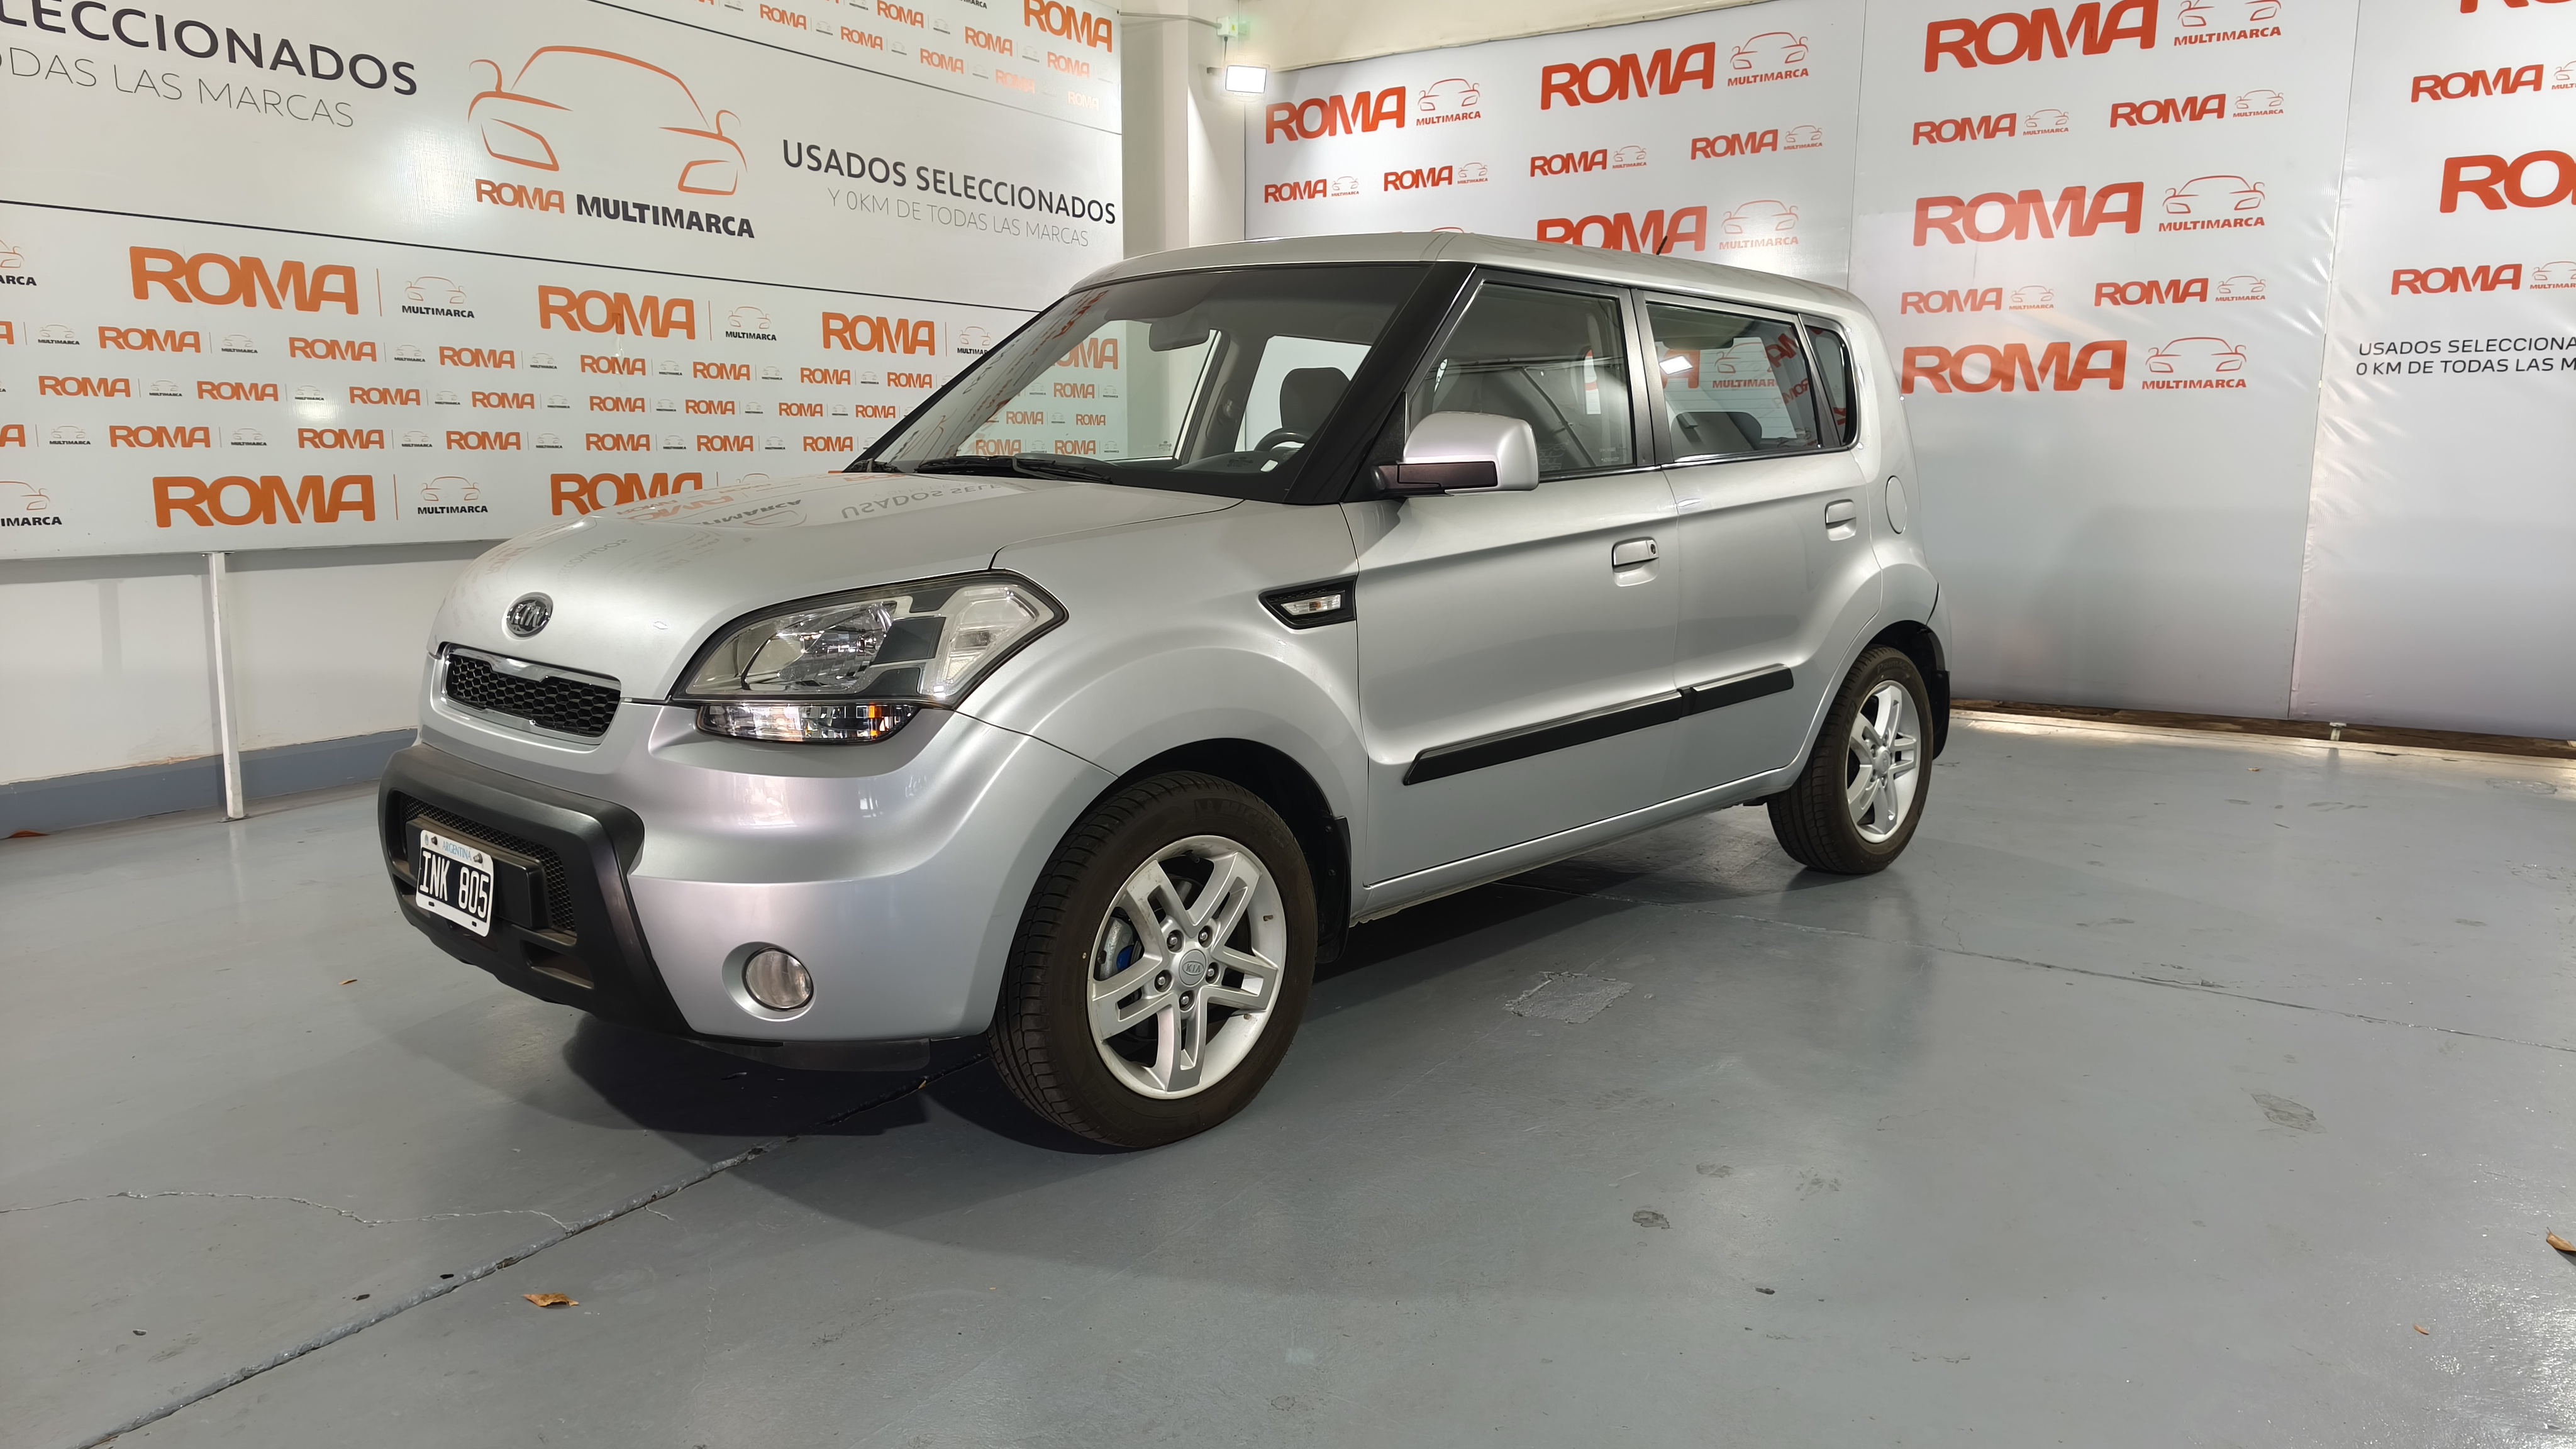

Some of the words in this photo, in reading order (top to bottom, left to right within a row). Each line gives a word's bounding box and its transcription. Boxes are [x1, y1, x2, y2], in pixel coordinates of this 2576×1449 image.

[760, 4, 807, 30] ROMA
[877, 0, 923, 28] ROMA
[841, 26, 883, 50] ROMA
[1024, 0, 1113, 53] ROMA
[1924, 0, 2158, 72] ROMA
[2174, 26, 2281, 47] MULTIMARCA
[965, 26, 1013, 57] ROMA
[920, 48, 964, 74] ROMA
[1048, 52, 1089, 78] ROMA
[0, 47, 96, 86] DAS
[114, 65, 182, 100] LAS
[199, 79, 354, 128] MARCAS
[996, 70, 1035, 94] ROMA
[1541, 42, 1716, 110] ROMA
[1728, 68, 1809, 86] MULTIMARCA
[2411, 64, 2544, 103] ROMA
[1068, 91, 1099, 111] ROMA
[2110, 94, 2226, 128] ROMA
[2233, 109, 2284, 118] MULTIMARCA
[1266, 86, 1406, 144] ROMA
[1416, 111, 1481, 126] MULTIMARCA
[1913, 113, 2017, 145] ROMA
[2023, 127, 2069, 136] MULTIMARCA
[1691, 129, 1778, 160] ROMA
[1784, 142, 1823, 151] MULTIMARCA
[1530, 149, 1607, 177] ROMA
[783, 140, 906, 187] USADOS
[916, 166, 1116, 225] SELECCIONADOS
[1384, 165, 1453, 191] ROMA
[2440, 150, 2576, 213] RO
[1264, 179, 1327, 203] ROMA
[475, 179, 565, 214] ROMA
[577, 194, 755, 238] MULTIMARCA
[828, 188, 840, 206] Y
[897, 199, 921, 221] DE
[926, 204, 987, 231] TODAS
[993, 218, 1020, 236] LAS
[1026, 221, 1089, 247] MARCAS
[1913, 181, 2145, 247] ROMA
[2158, 217, 2265, 232] MULTIMARCA
[1537, 206, 1707, 255] ROMA
[1719, 235, 1799, 250] MULTIMARCA
[129, 246, 358, 315] ROMA
[402, 306, 474, 318] MULTIMARCA
[2391, 264, 2523, 295] ROMA
[1901, 287, 2003, 314] ROMA
[2094, 278, 2209, 307] ROMA
[538, 285, 696, 340] ROMA
[726, 331, 777, 341] MULTIMARCA
[98, 326, 201, 352] ROMA
[822, 311, 936, 356] ROMA
[289, 337, 377, 362] ROMA
[439, 347, 514, 370] ROMA
[1054, 338, 1118, 370] OMA
[2359, 340, 2441, 356] USADOS
[580, 355, 646, 376] ROMA
[693, 362, 750, 380] ROMA
[801, 367, 851, 386] ROMA
[1901, 340, 2128, 394] ROMA
[2141, 379, 2246, 390] MULTIMARCA
[2373, 362, 2401, 375] KM
[2408, 361, 2434, 374] DE
[2440, 359, 2509, 373] TODAS
[2516, 358, 2554, 371] LAS
[39, 375, 131, 397] ROMA
[197, 381, 279, 401] ROMA
[887, 372, 932, 389] ROMA
[1053, 382, 1094, 399] ROMA
[1713, 379, 1777, 389] MULTIMAR
[349, 387, 421, 406] ROMA
[472, 391, 535, 409] ROMA
[589, 396, 645, 413] ROMA
[686, 399, 735, 415] ROMA
[779, 402, 823, 417] ROMA
[855, 404, 896, 419] ROMA
[1006, 411, 1043, 425] ROMA
[1076, 414, 1106, 426] ROMA
[109, 425, 210, 448] ROMA
[298, 428, 385, 450] ROMA
[446, 431, 521, 450] ROMA
[586, 433, 650, 452] ROMA
[697, 435, 753, 452] ROMA
[803, 436, 853, 452] ROMA
[975, 439, 1021, 456] ROMA
[1054, 440, 1096, 455] ROMA
[153, 475, 375, 528] ROMA
[418, 506, 488, 514] MULTIMARCA
[0, 517, 62, 526] IMARCA
[442, 841, 472, 861] ARGENTINA
[419, 850, 450, 901] INK
[458, 867, 489, 919] 805
[1185, 963, 1201, 973] KIA
